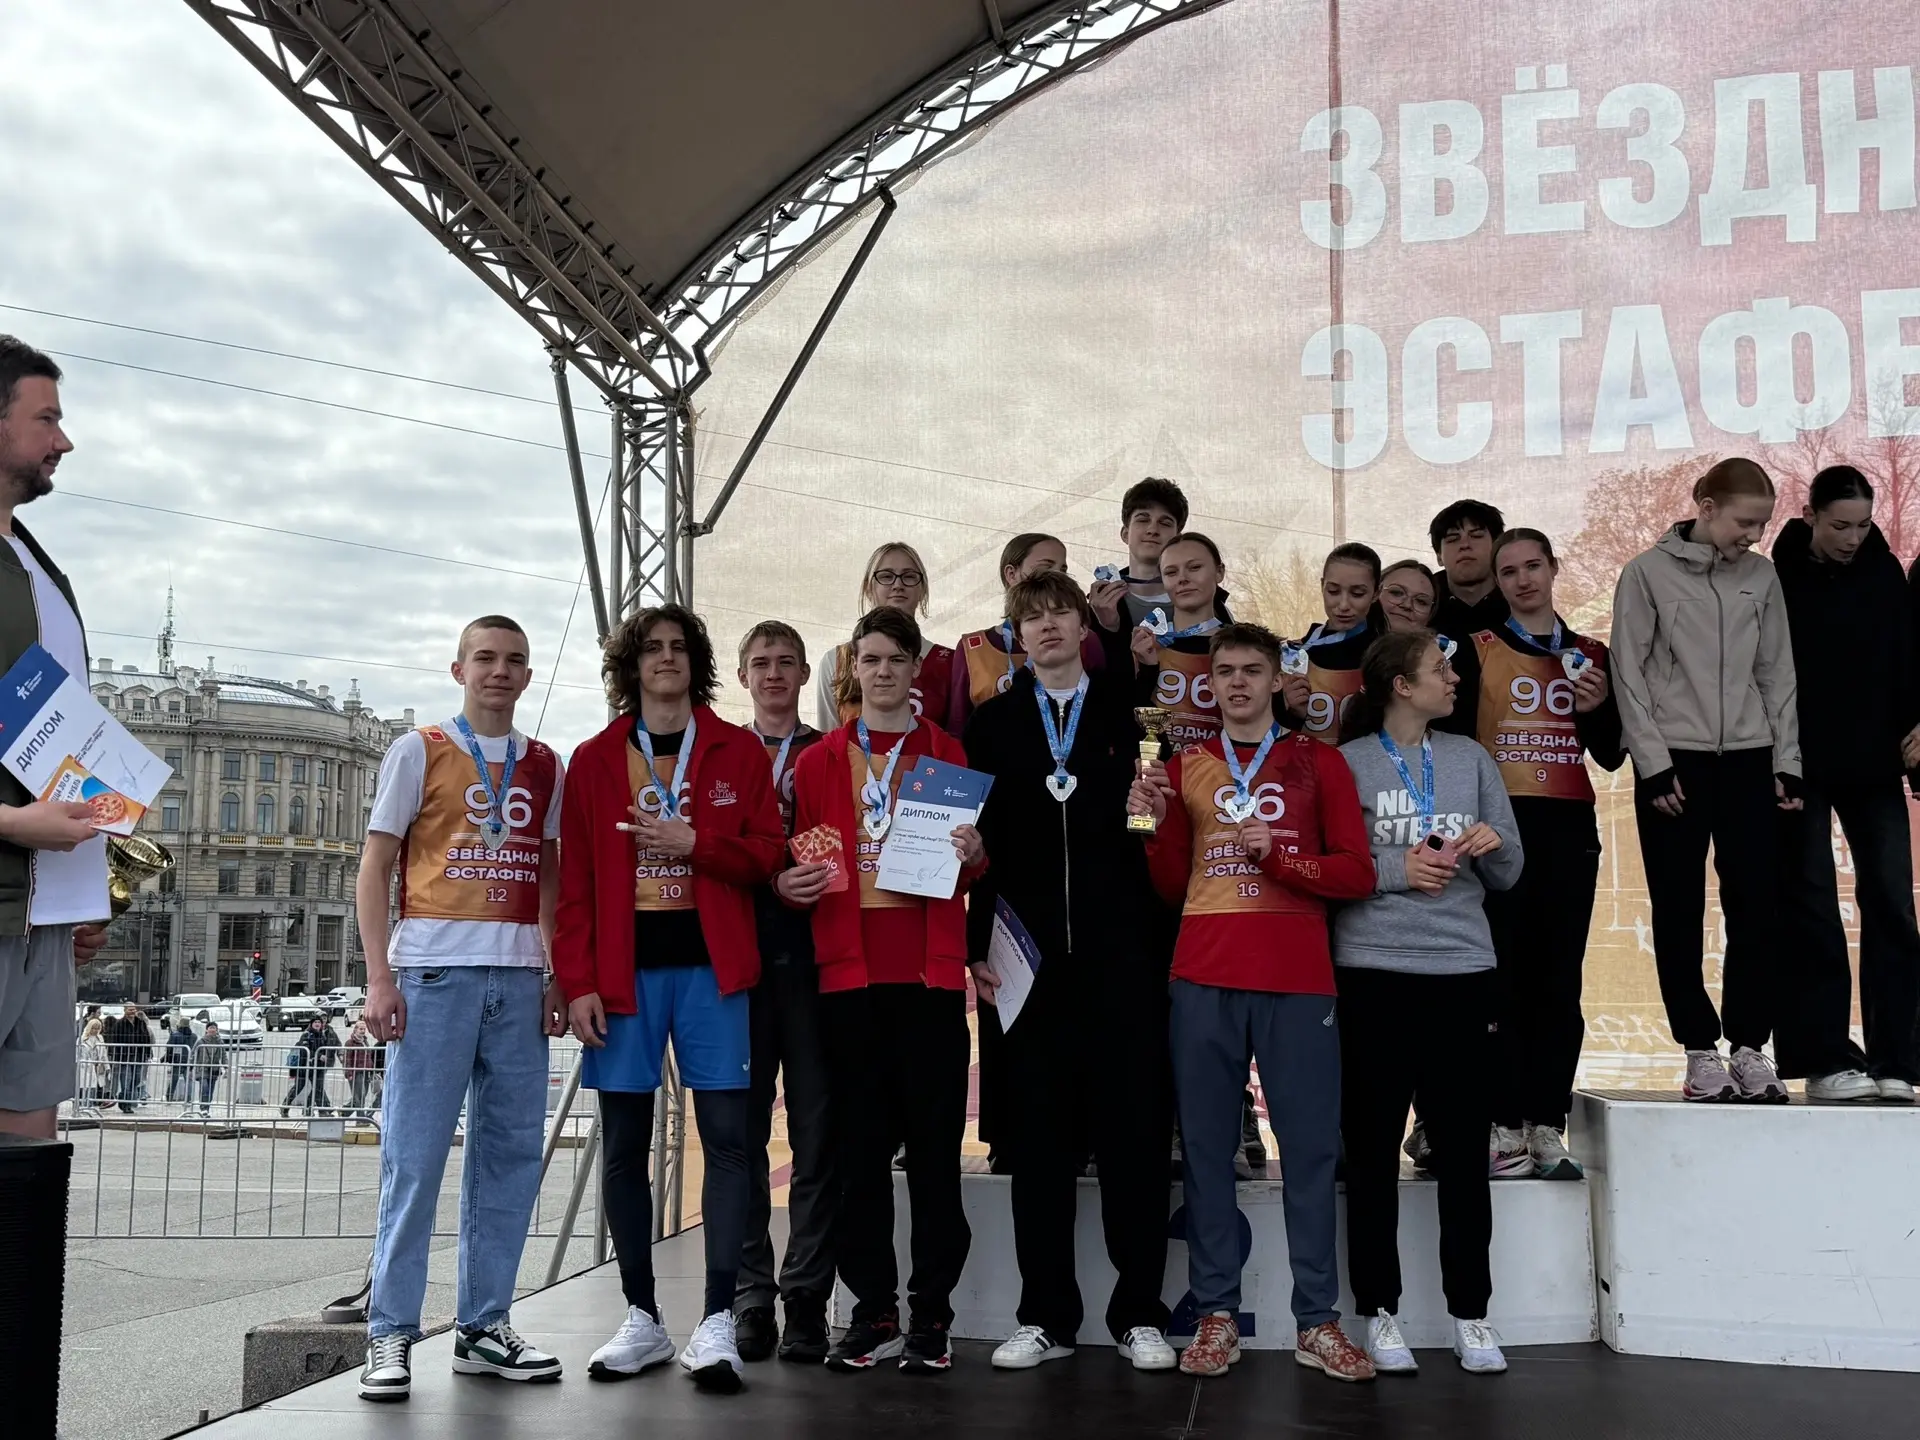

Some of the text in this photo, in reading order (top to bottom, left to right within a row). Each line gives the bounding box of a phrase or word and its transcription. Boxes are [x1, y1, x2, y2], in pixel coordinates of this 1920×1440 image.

[1300, 64, 1917, 251] ЗВЁЗДН
[1300, 289, 1920, 470] ЭСТАФЕ
[1156, 669, 1217, 709] 96
[1510, 675, 1576, 716] 96
[15, 709, 65, 773] ДИПЛОМ
[1495, 731, 1581, 748] ЗВЁЗДНА
[1536, 769, 1547, 782] 9
[464, 783, 533, 828] 96
[900, 807, 951, 822] ДИПЛОМ
[1214, 782, 1286, 824] 96
[1377, 789, 1417, 817] NO
[446, 845, 540, 865] ЗВЁЗДНАЯ
[445, 866, 537, 883] ЭСТАФЕТА
[486, 888, 508, 902] 12
[660, 885, 682, 899] 10
[1237, 882, 1260, 898] 16
